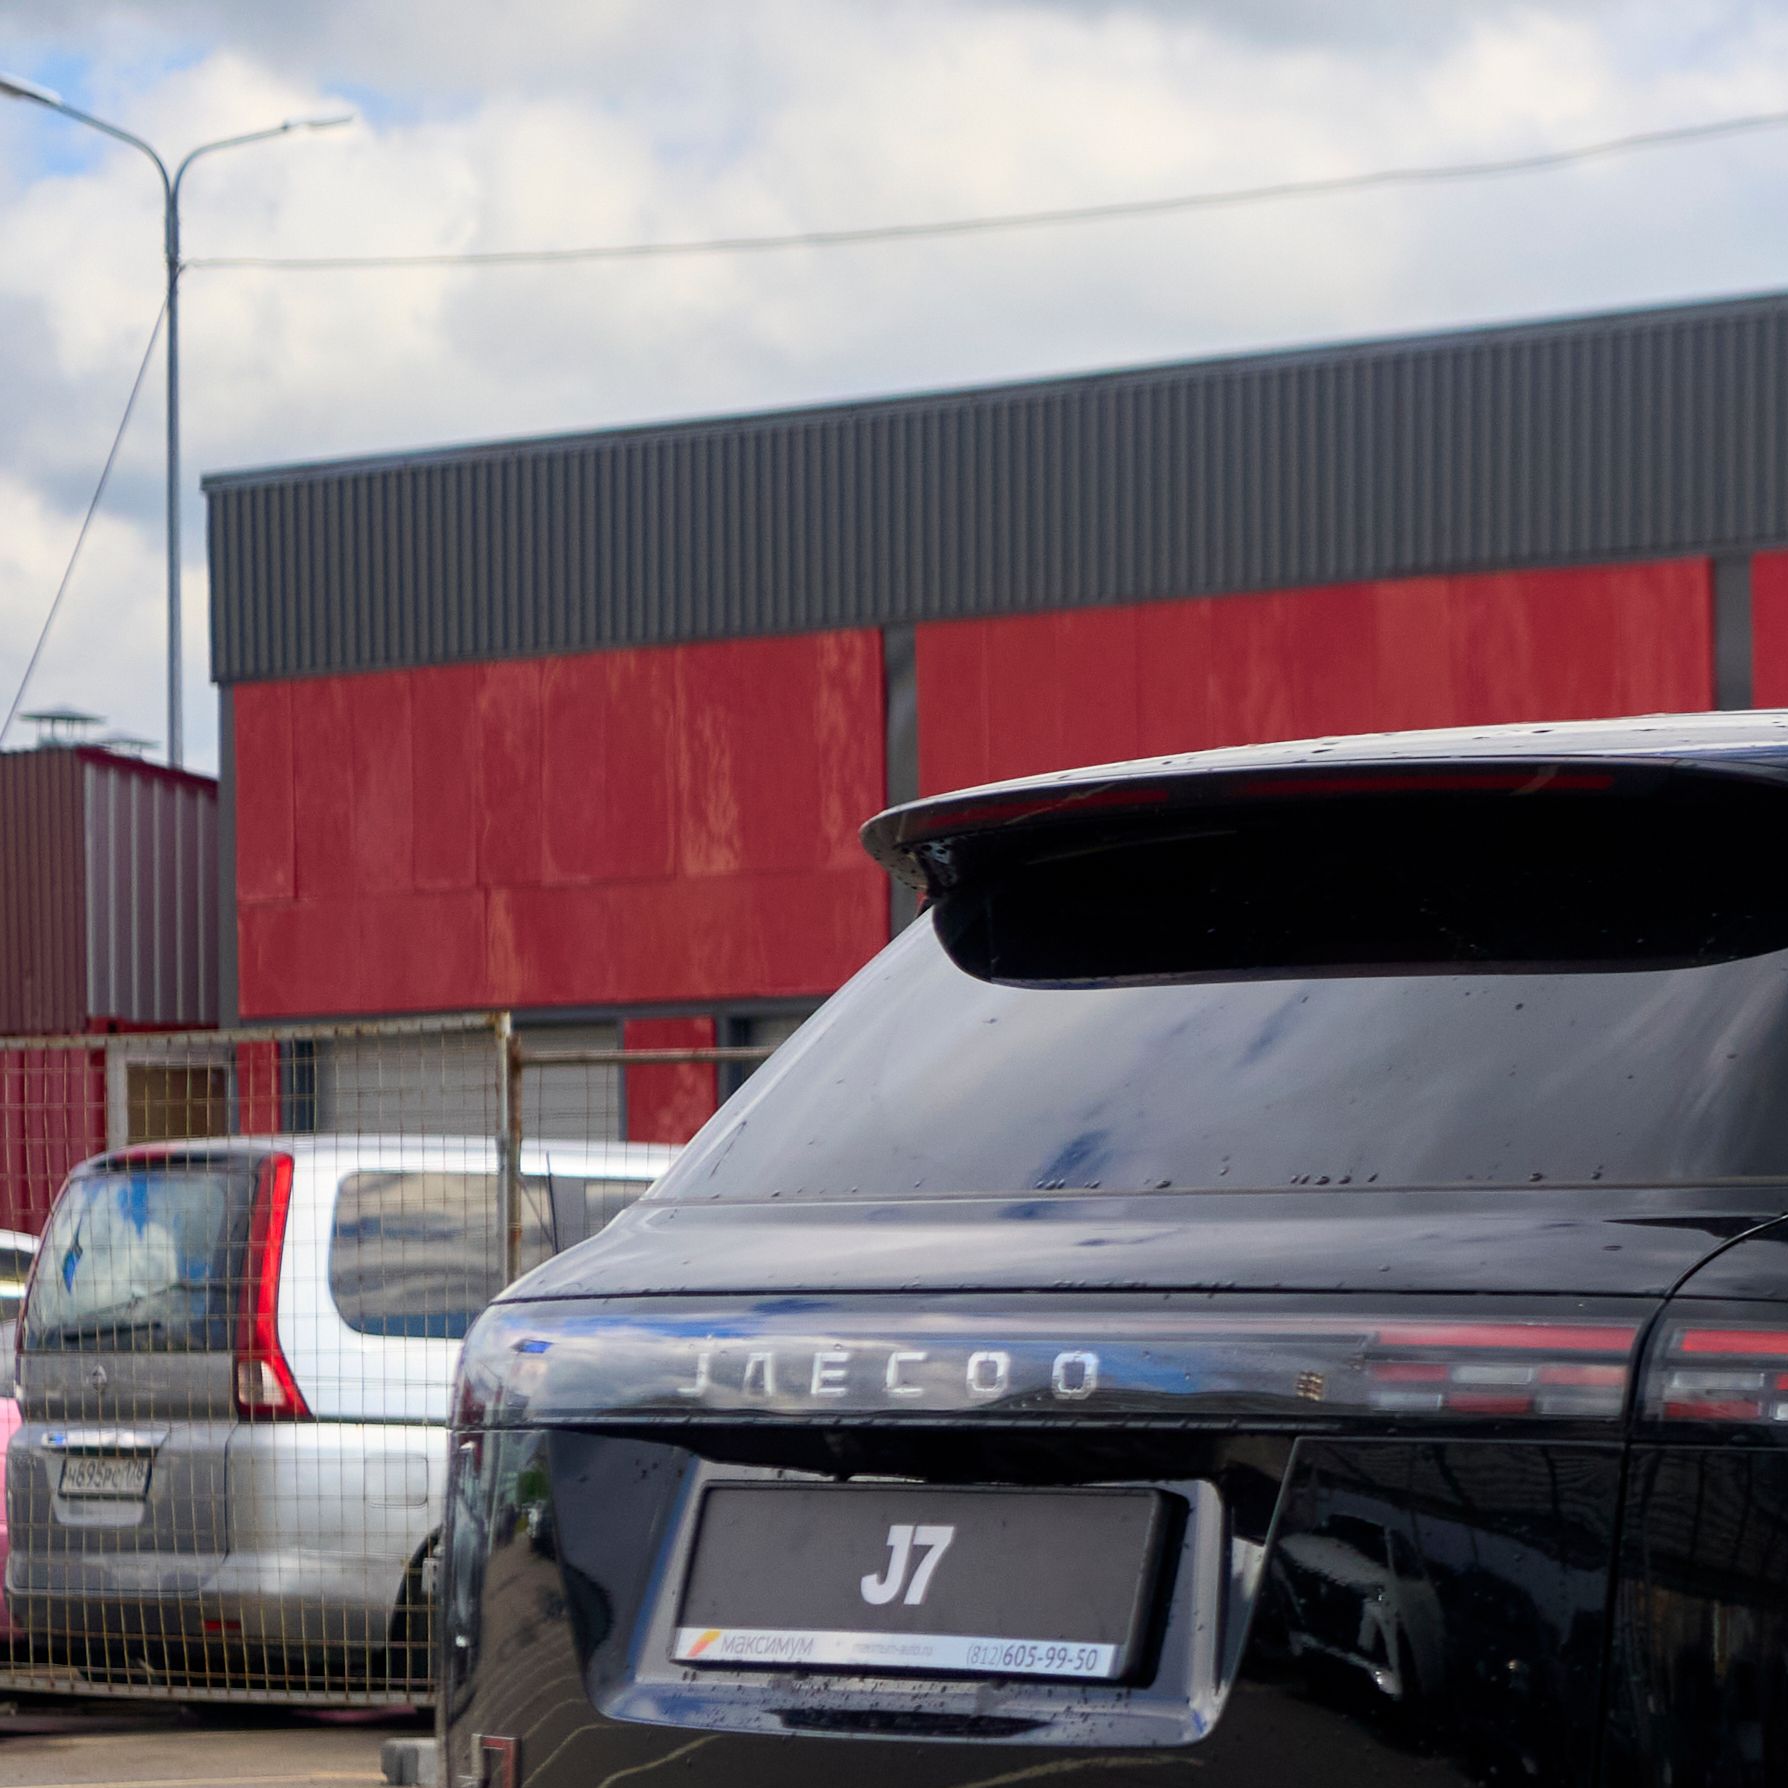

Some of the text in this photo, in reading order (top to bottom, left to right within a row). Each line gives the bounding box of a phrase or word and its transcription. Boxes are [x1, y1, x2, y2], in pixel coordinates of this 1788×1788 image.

[677, 1350, 1098, 1399] JAECOO
[860, 1525, 956, 1606] J7
[720, 1634, 815, 1661] максимум
